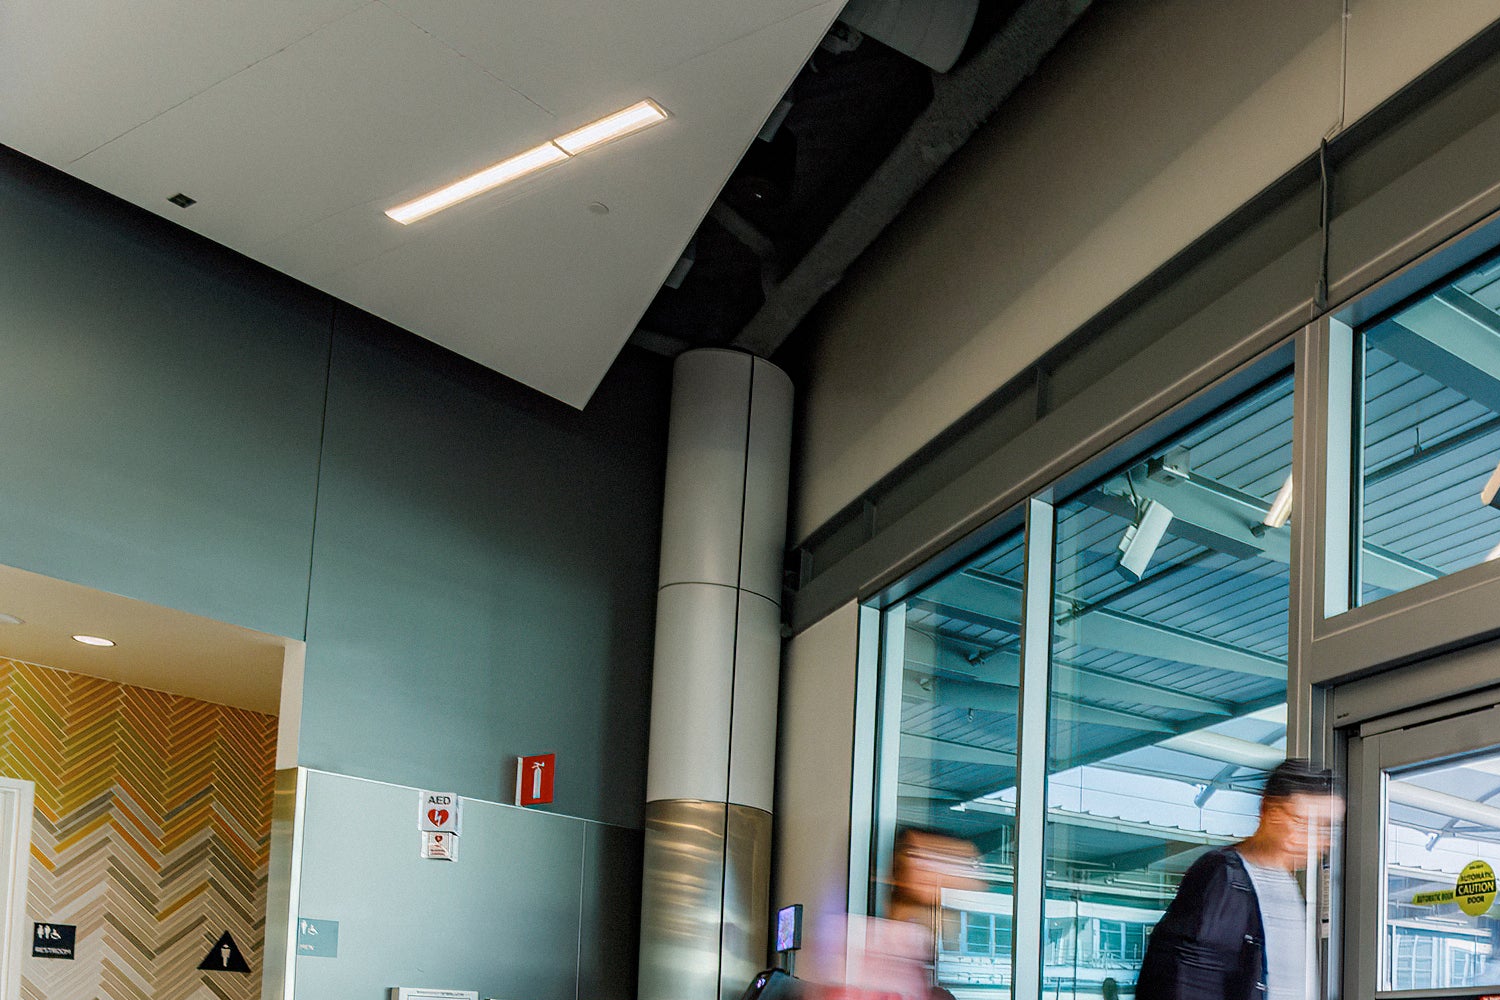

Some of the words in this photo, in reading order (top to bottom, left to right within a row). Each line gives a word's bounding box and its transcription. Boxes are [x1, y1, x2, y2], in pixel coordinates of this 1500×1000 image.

[428, 796, 451, 805] AED
[1458, 881, 1494, 895] CAUTION
[1467, 896, 1485, 904] DOOR
